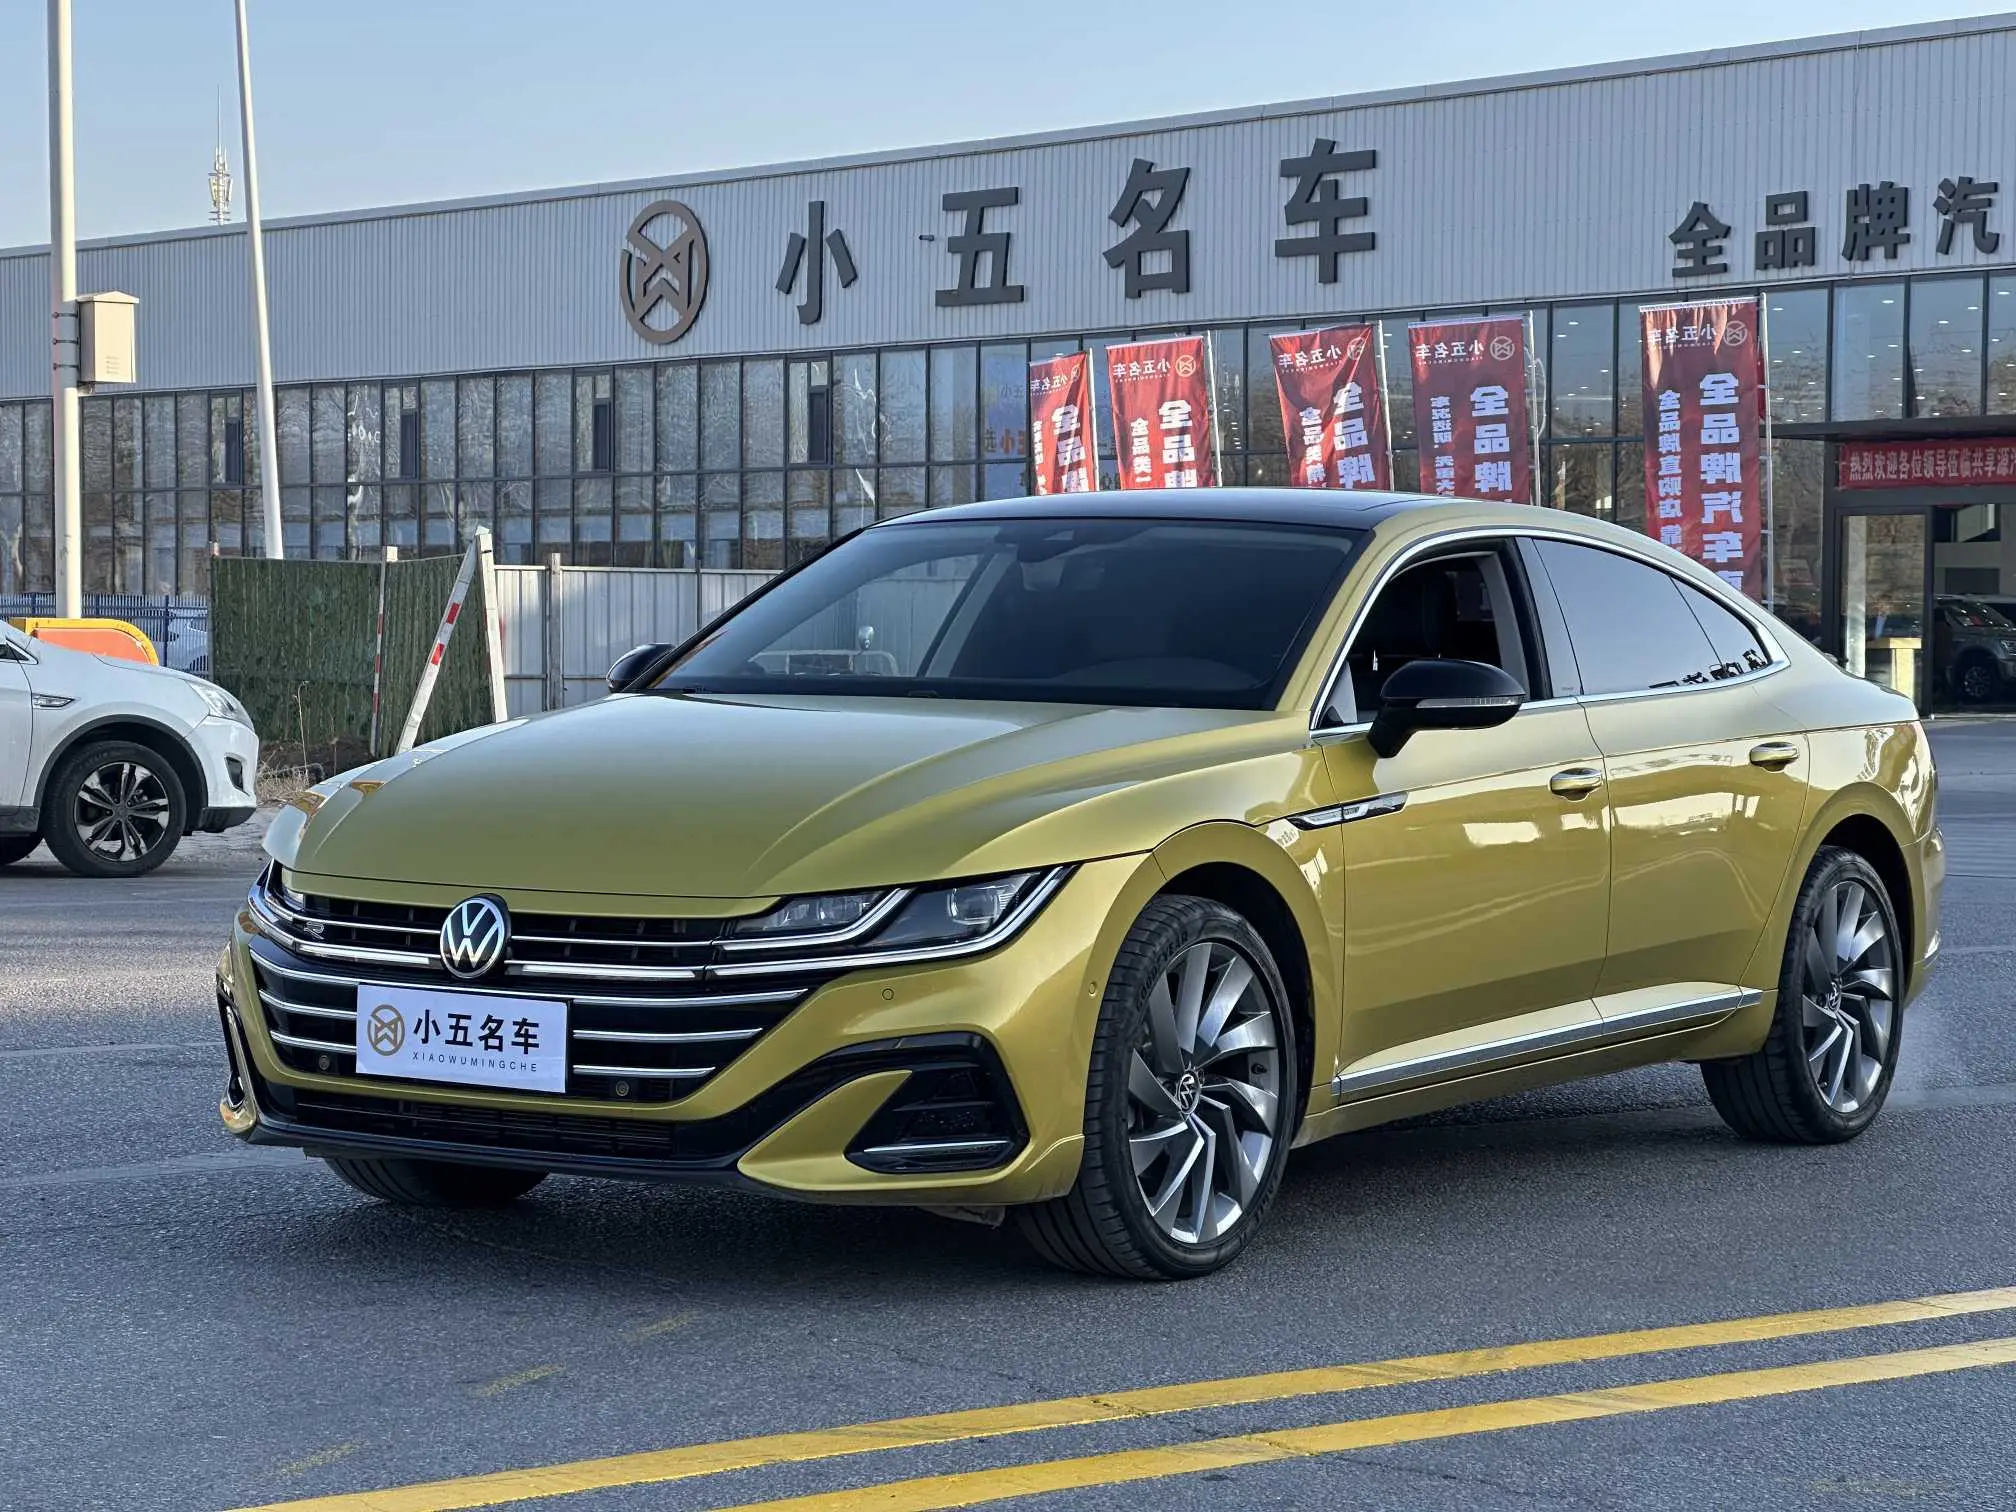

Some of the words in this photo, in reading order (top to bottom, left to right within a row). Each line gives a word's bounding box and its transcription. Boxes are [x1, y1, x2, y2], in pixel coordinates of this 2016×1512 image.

[776, 138, 1377, 325] 小五名车
[1668, 175, 2000, 278] 全品牌汽
[412, 1052, 538, 1073] XIAOWUMINGCHE
[413, 1009, 540, 1055] 小五名车
